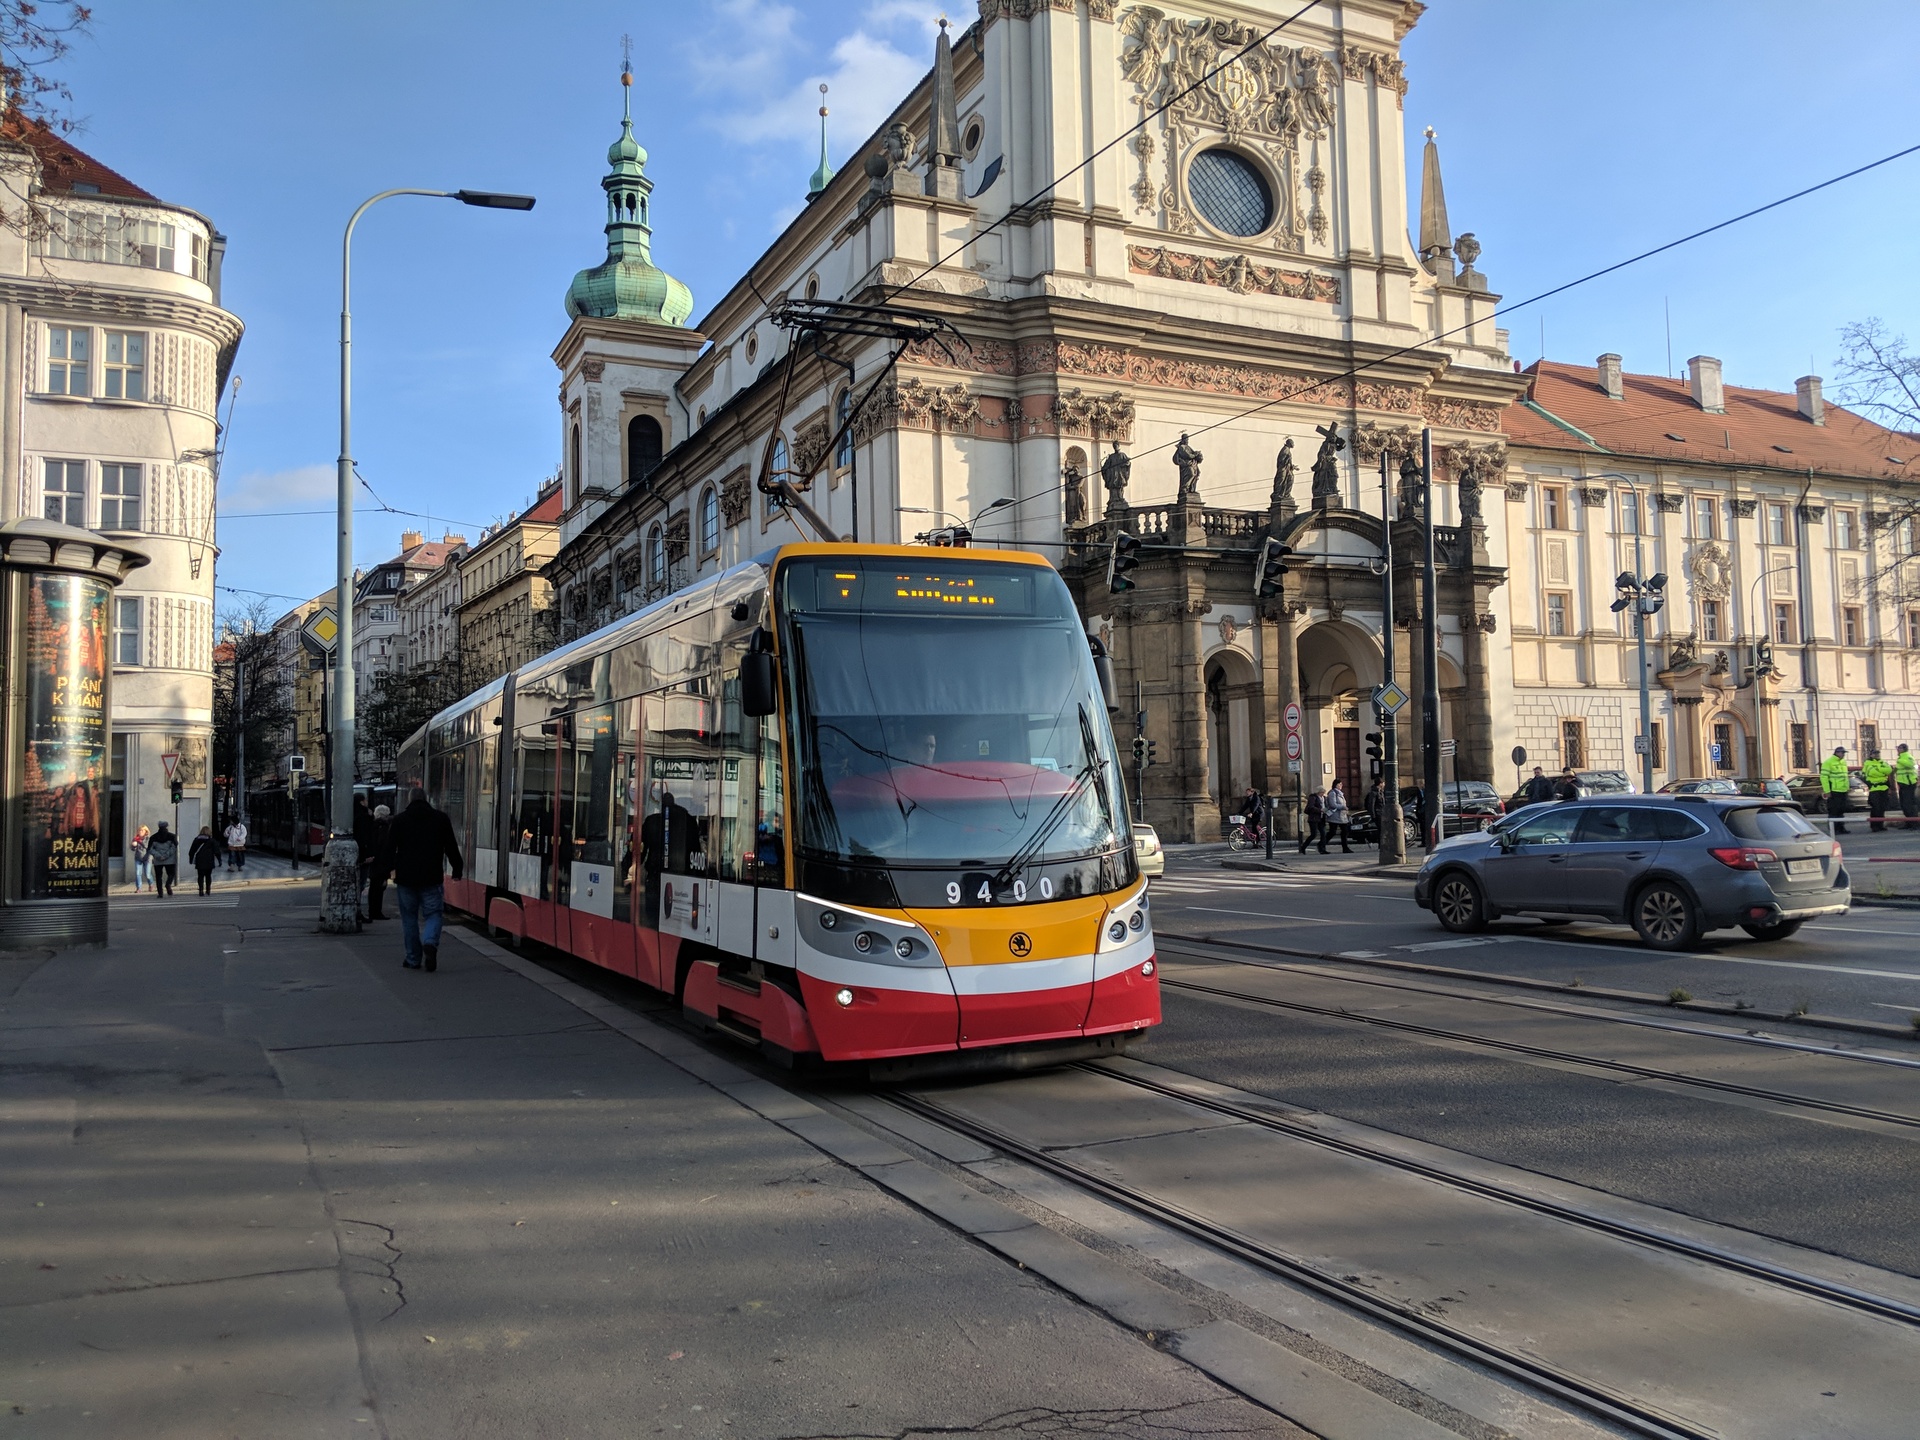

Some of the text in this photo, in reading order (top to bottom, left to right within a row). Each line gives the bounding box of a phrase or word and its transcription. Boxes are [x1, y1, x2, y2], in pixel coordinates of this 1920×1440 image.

[1215, 62, 1255, 98] IHS
[57, 676, 102, 693] PÁNÍ
[52, 692, 103, 709] K MÁNÍ
[53, 837, 98, 853] PŘÁNÍ
[48, 853, 99, 869] K MÁNÍ
[690, 851, 706, 871] 9400
[946, 877, 1053, 904] 9400
